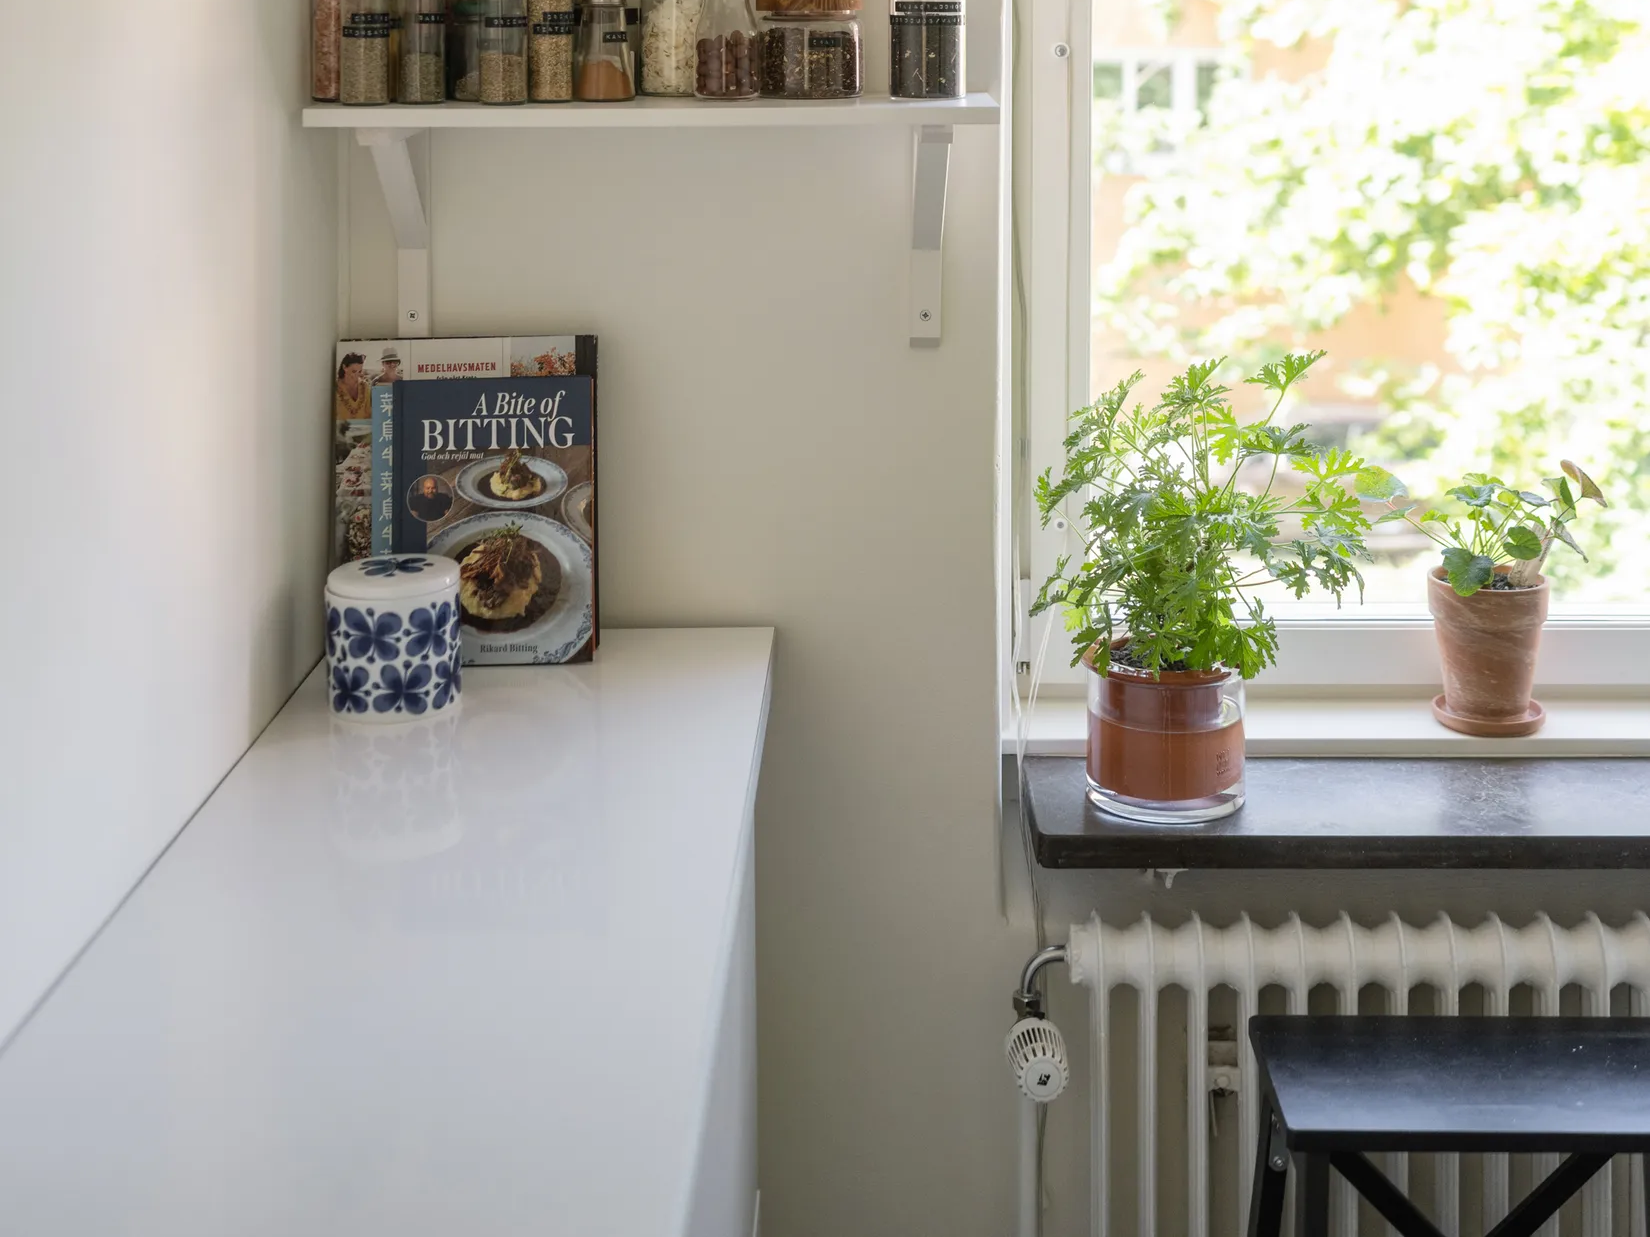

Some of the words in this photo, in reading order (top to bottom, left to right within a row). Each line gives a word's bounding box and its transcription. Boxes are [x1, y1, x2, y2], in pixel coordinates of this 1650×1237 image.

[417, 362, 496, 373] MEDELHAVSMATEN
[471, 393, 489, 415] A
[493, 392, 536, 415] Bite
[540, 390, 566, 422] of
[421, 416, 575, 452] BITTING
[421, 452, 436, 460] God
[437, 451, 450, 460] och
[451, 451, 469, 462] rejäl
[480, 643, 508, 653] Rikard
[510, 643, 539, 654] Bitting
